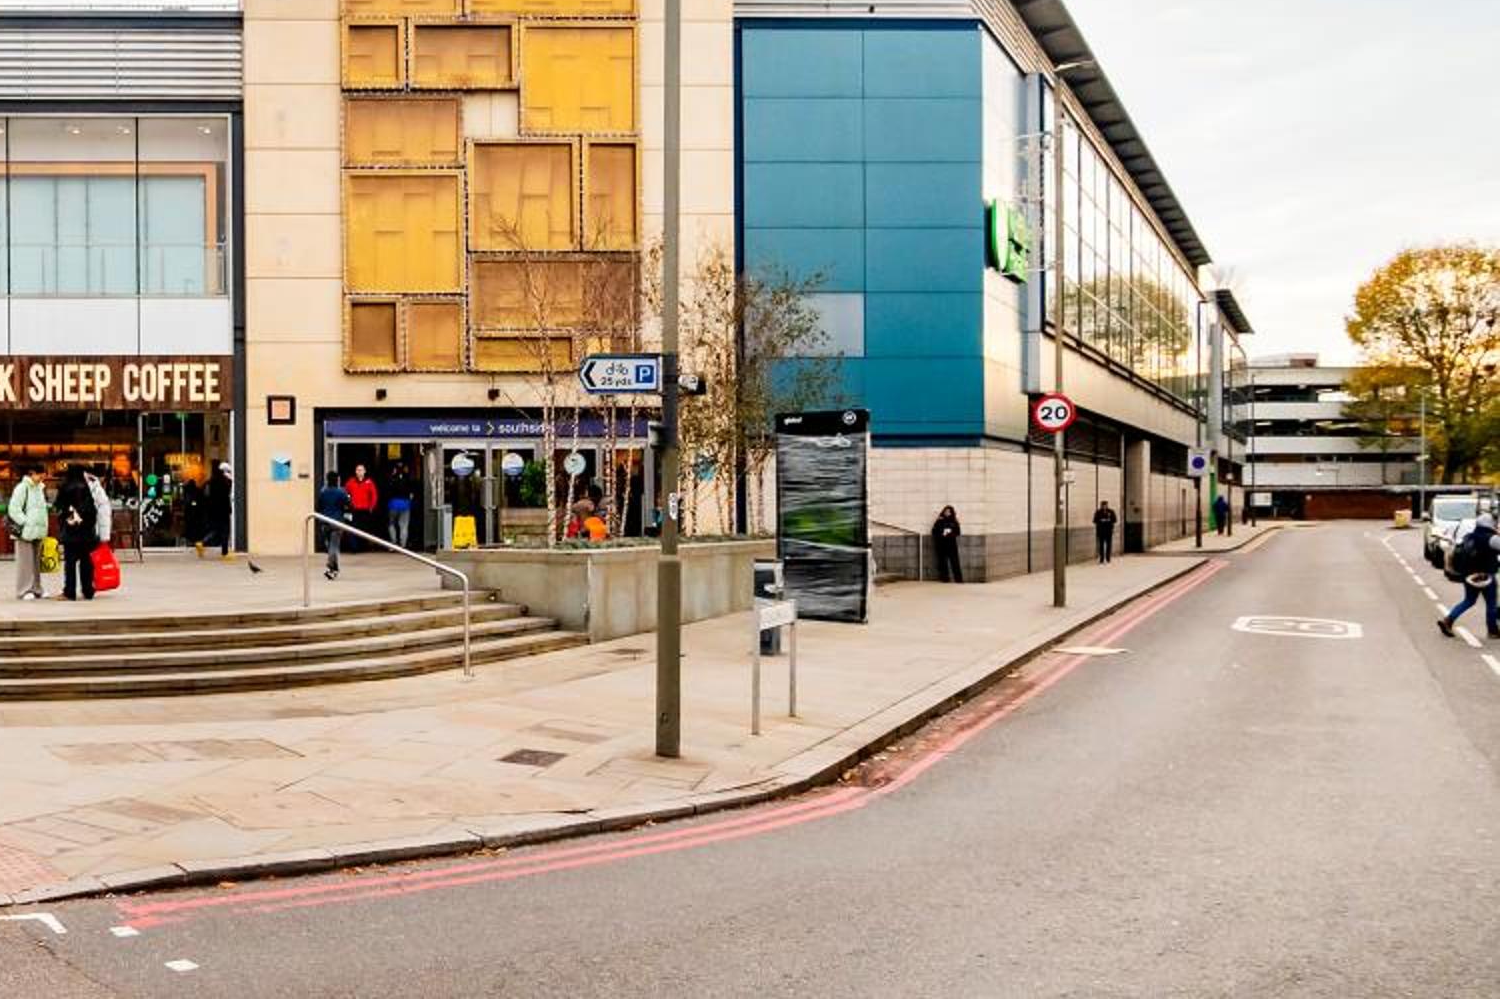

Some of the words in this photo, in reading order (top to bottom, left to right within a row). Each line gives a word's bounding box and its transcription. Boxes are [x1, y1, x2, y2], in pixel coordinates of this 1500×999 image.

[601, 377, 613, 386] 25
[639, 366, 651, 382] P
[29, 363, 111, 402] SHEEP
[123, 363, 221, 402] COFFEE
[1041, 405, 1068, 420] 20
[430, 424, 469, 433] welcome
